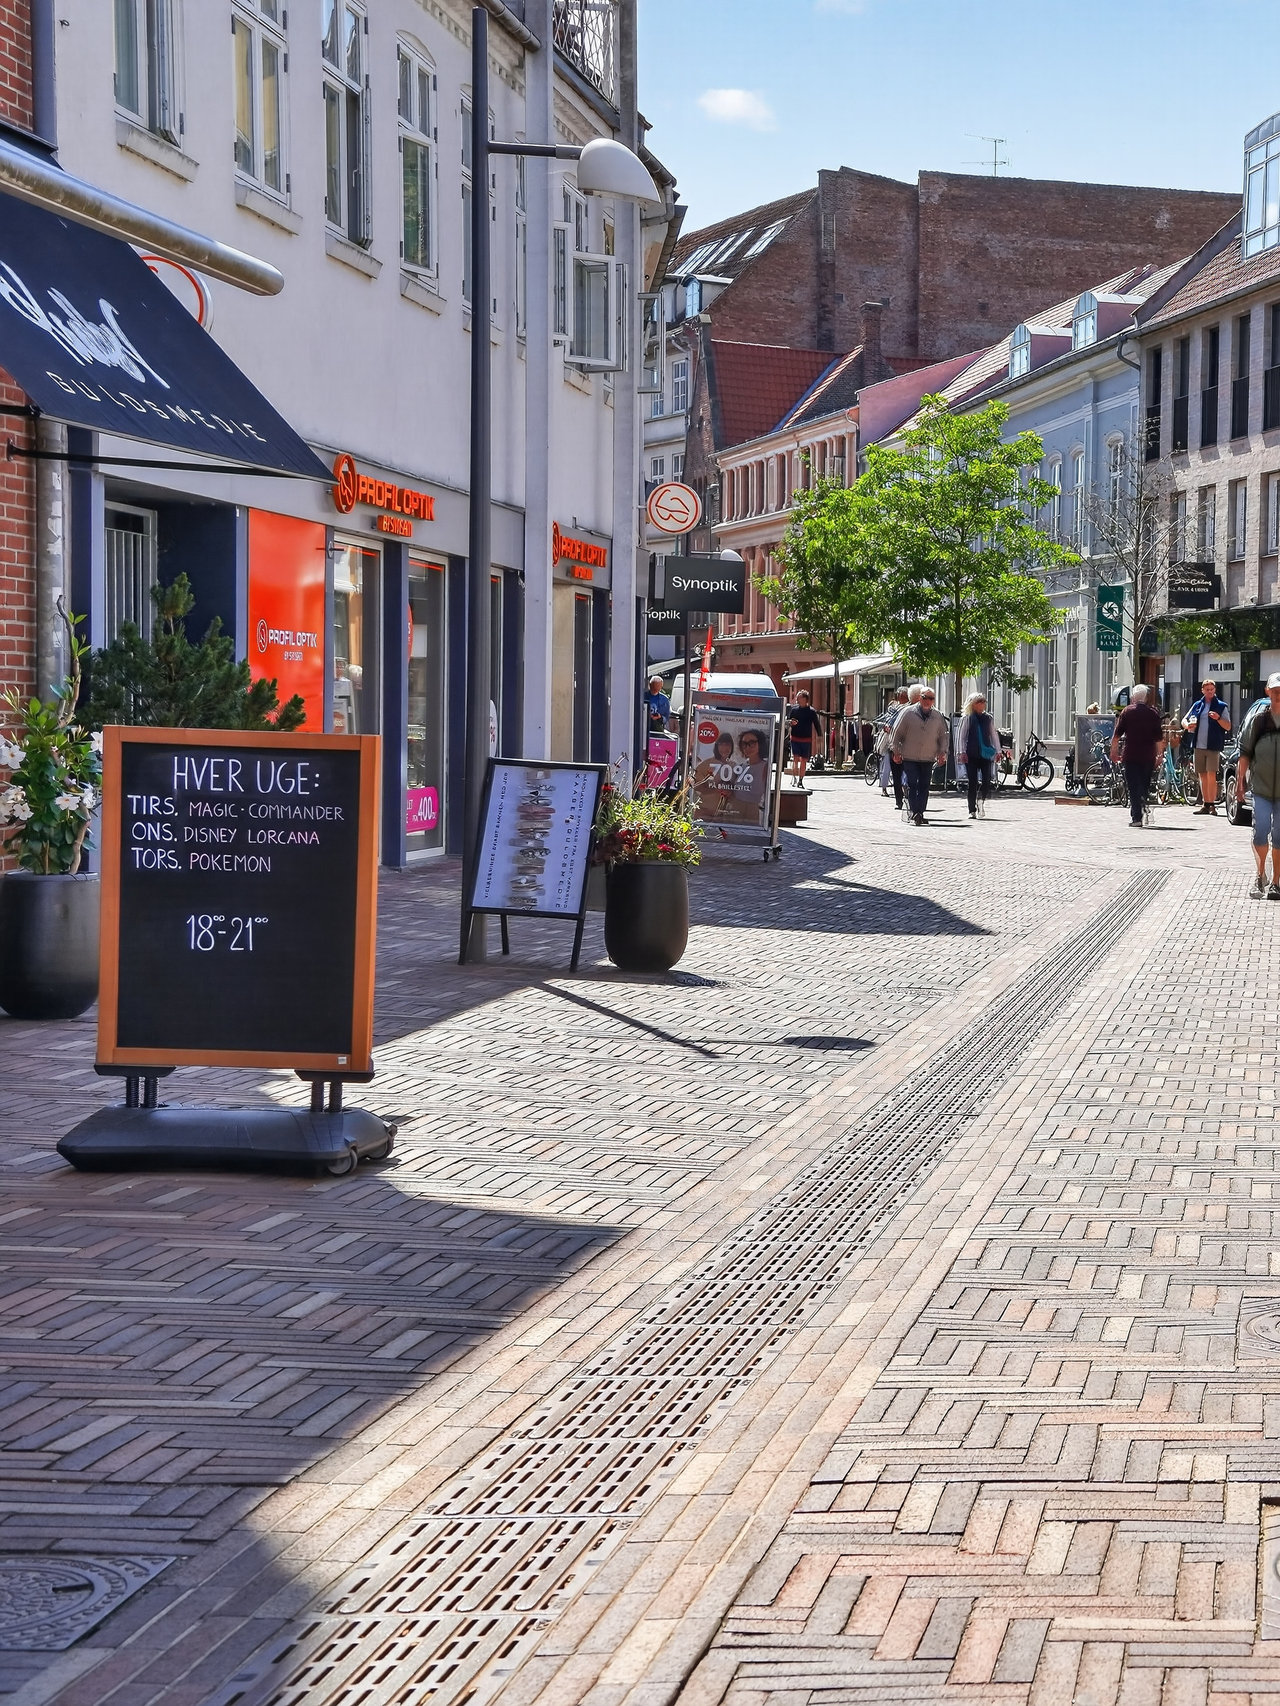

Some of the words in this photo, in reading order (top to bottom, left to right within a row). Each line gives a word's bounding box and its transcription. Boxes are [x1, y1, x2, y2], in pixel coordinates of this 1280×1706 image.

[46, 370, 268, 443] GULDSMEDIE
[357, 474, 401, 513] PROFIL
[399, 487, 435, 521] OPTIK
[672, 576, 738, 593] Synoptik
[268, 629, 295, 646] PROFIL
[296, 632, 317, 648] OPTIK
[173, 757, 244, 792] HVER
[257, 761, 321, 795] UGE:
[709, 763, 754, 784] 70%
[127, 795, 178, 816] TIRS.
[189, 801, 238, 818] MAGIC
[248, 803, 344, 821] COMMANDER
[131, 822, 178, 843] ONS.
[184, 826, 237, 843] DISNEY
[248, 829, 320, 844] LORCANA
[131, 847, 182, 869] TORS.
[189, 853, 271, 873] POKEMON
